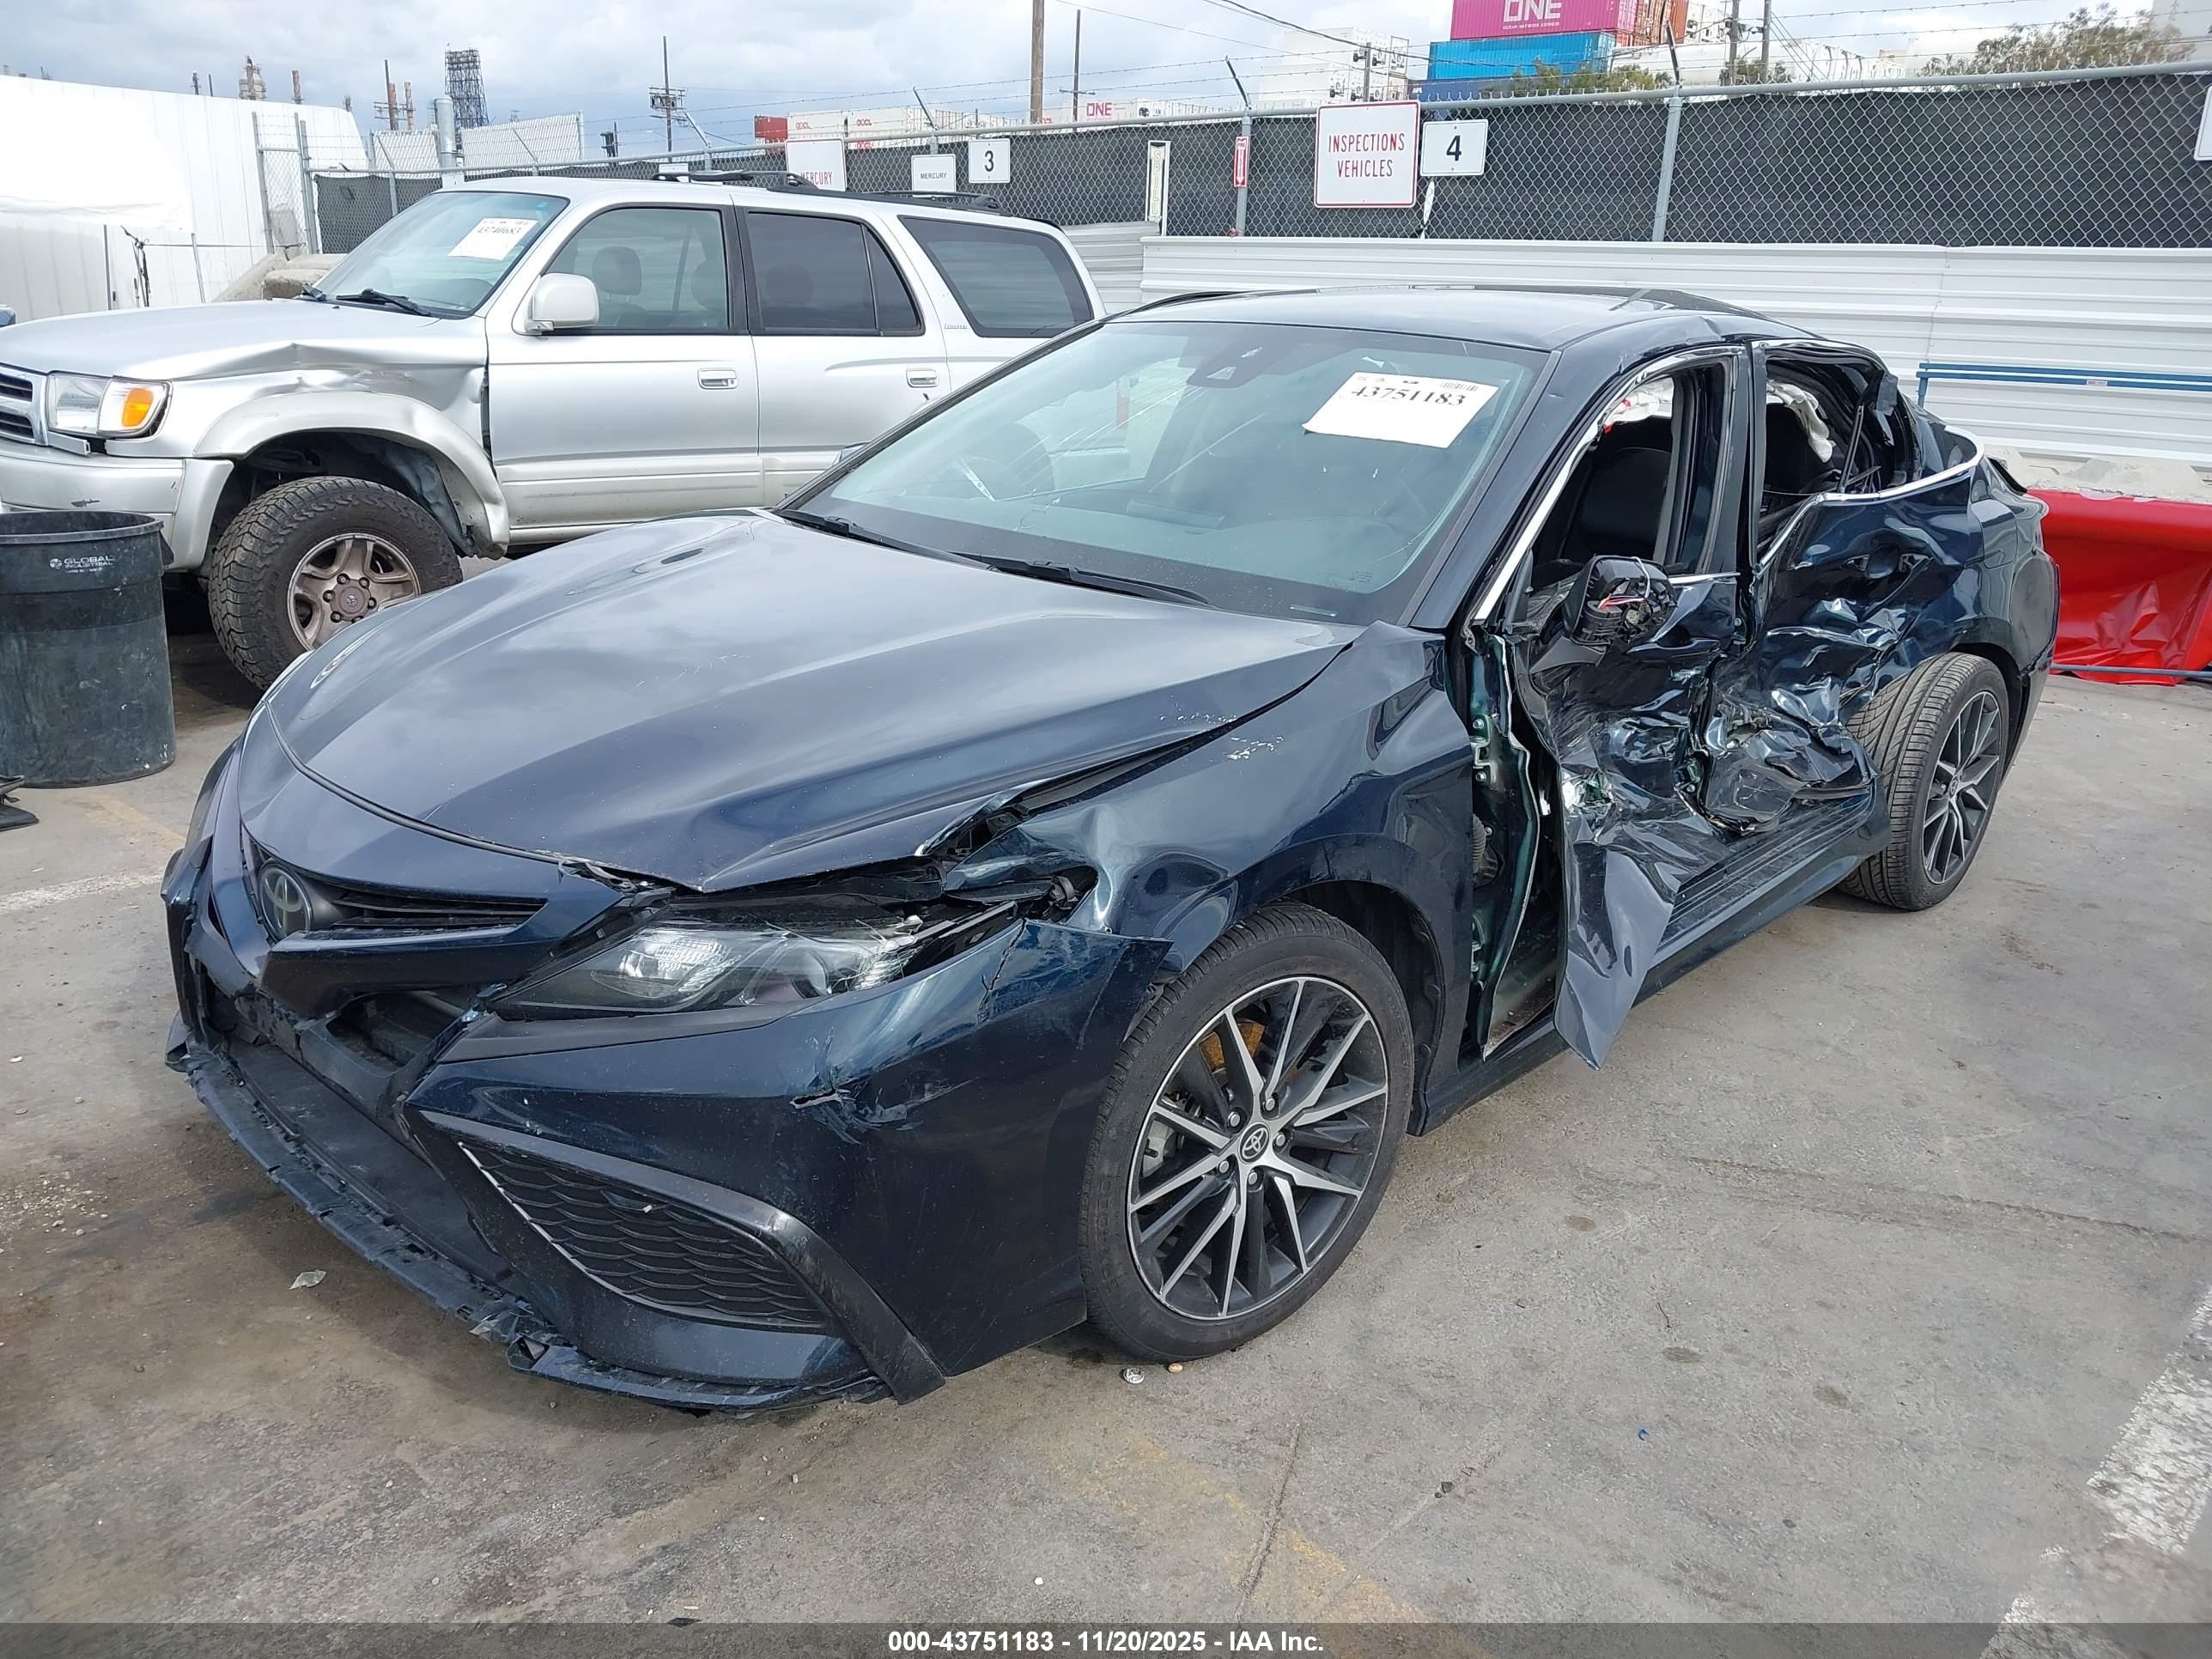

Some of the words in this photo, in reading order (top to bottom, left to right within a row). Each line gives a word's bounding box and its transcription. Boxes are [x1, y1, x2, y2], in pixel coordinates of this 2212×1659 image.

[1504, 0, 1562, 21] ONE
[1086, 102, 1112, 117] ONE
[1328, 133, 1405, 153] INSPECTIONS
[1446, 135, 1462, 161] 4
[984, 150, 994, 172] 3
[1337, 160, 1393, 178] VEHICLES
[1352, 386, 1466, 405] 43751183
